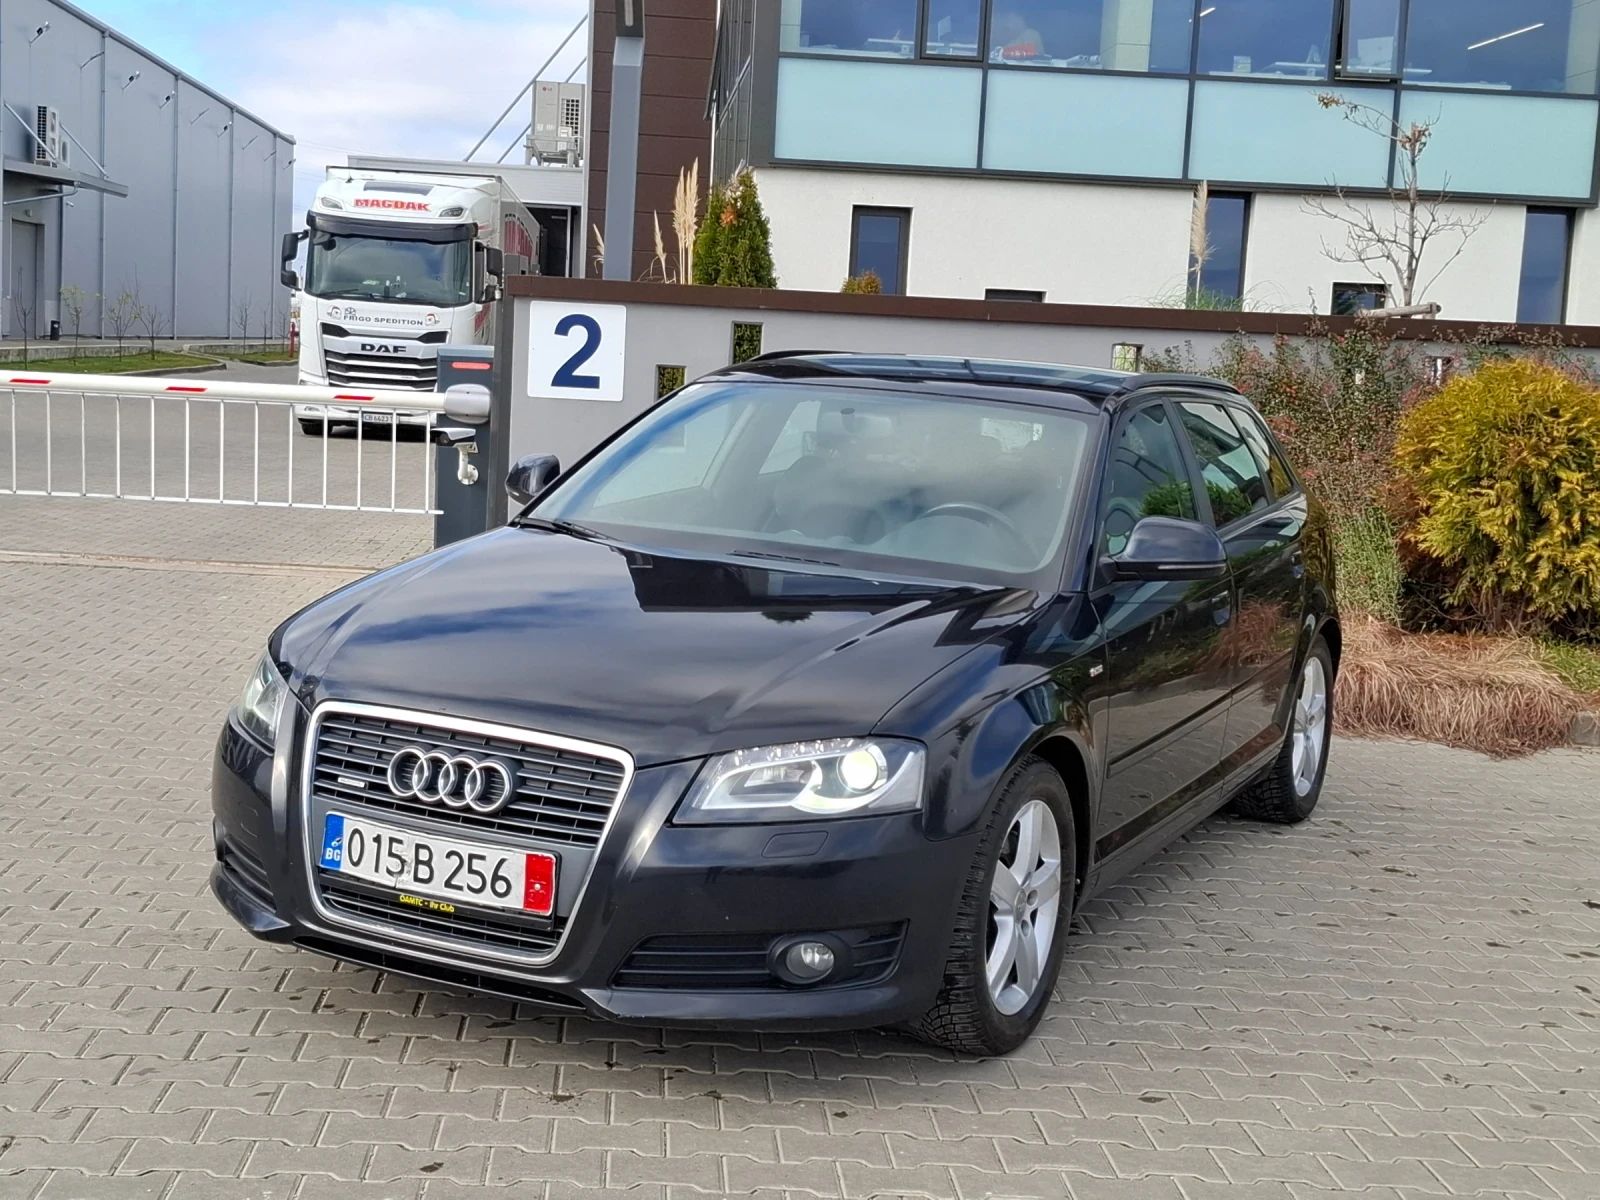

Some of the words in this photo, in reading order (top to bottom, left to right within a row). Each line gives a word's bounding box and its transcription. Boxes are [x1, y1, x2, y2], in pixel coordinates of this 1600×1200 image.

[354, 198, 432, 212] MAGDAK
[343, 315, 372, 323] FRIGO
[374, 317, 424, 326] SPEDITION
[361, 343, 407, 354] DAF
[551, 313, 602, 390] 2
[325, 847, 341, 862] BG
